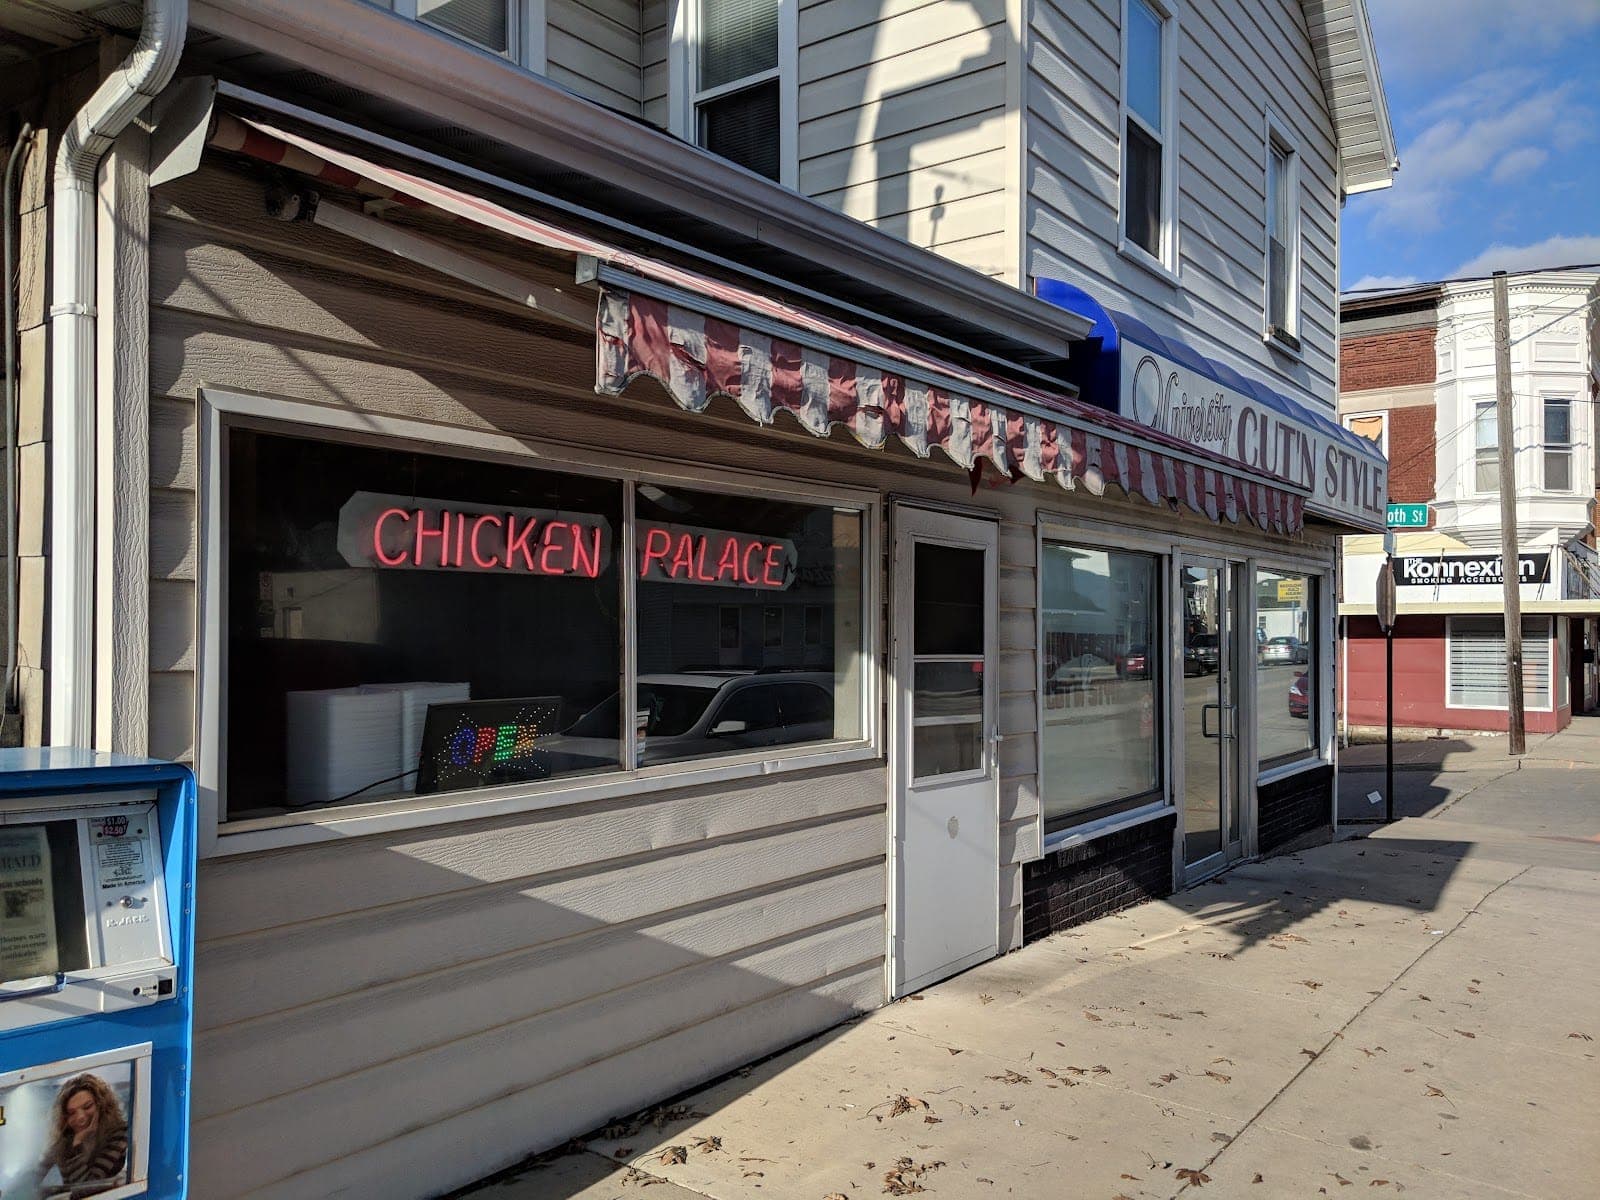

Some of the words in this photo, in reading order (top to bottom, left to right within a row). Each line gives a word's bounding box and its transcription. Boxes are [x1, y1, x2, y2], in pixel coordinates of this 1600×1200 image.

[1237, 406, 1316, 494] CUT'N
[1325, 444, 1384, 514] STYLE
[1412, 510, 1424, 522] St
[374, 508, 600, 578] CHICKEN
[640, 528, 783, 586] PALACE
[450, 724, 538, 767] OPEN
